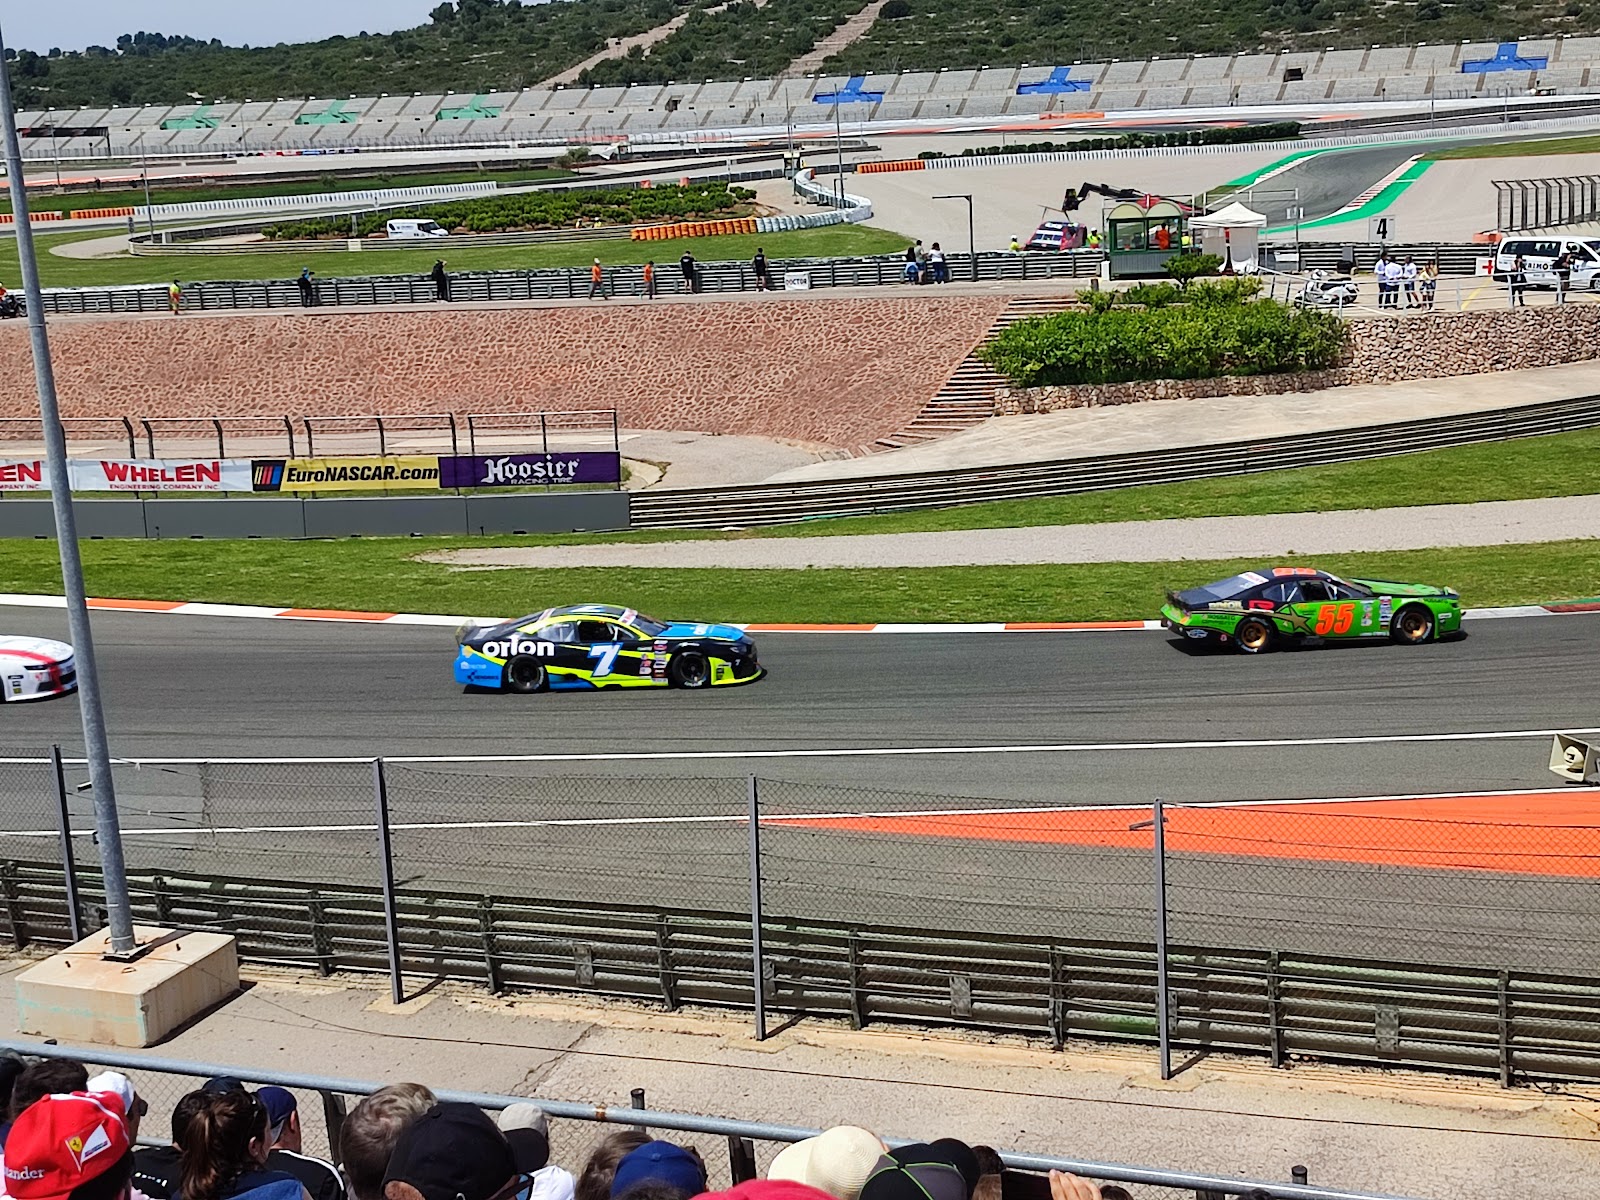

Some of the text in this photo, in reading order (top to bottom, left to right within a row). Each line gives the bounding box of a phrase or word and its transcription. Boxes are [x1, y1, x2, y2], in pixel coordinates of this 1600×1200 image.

[1376, 218, 1388, 239] 4
[786, 278, 807, 286] DOCTOR
[100, 460, 220, 482] WHELEN
[286, 466, 438, 482] EuroNASCAR.com
[480, 454, 579, 484] Hoosier
[1314, 603, 1355, 635] 55
[589, 643, 622, 678] 7
